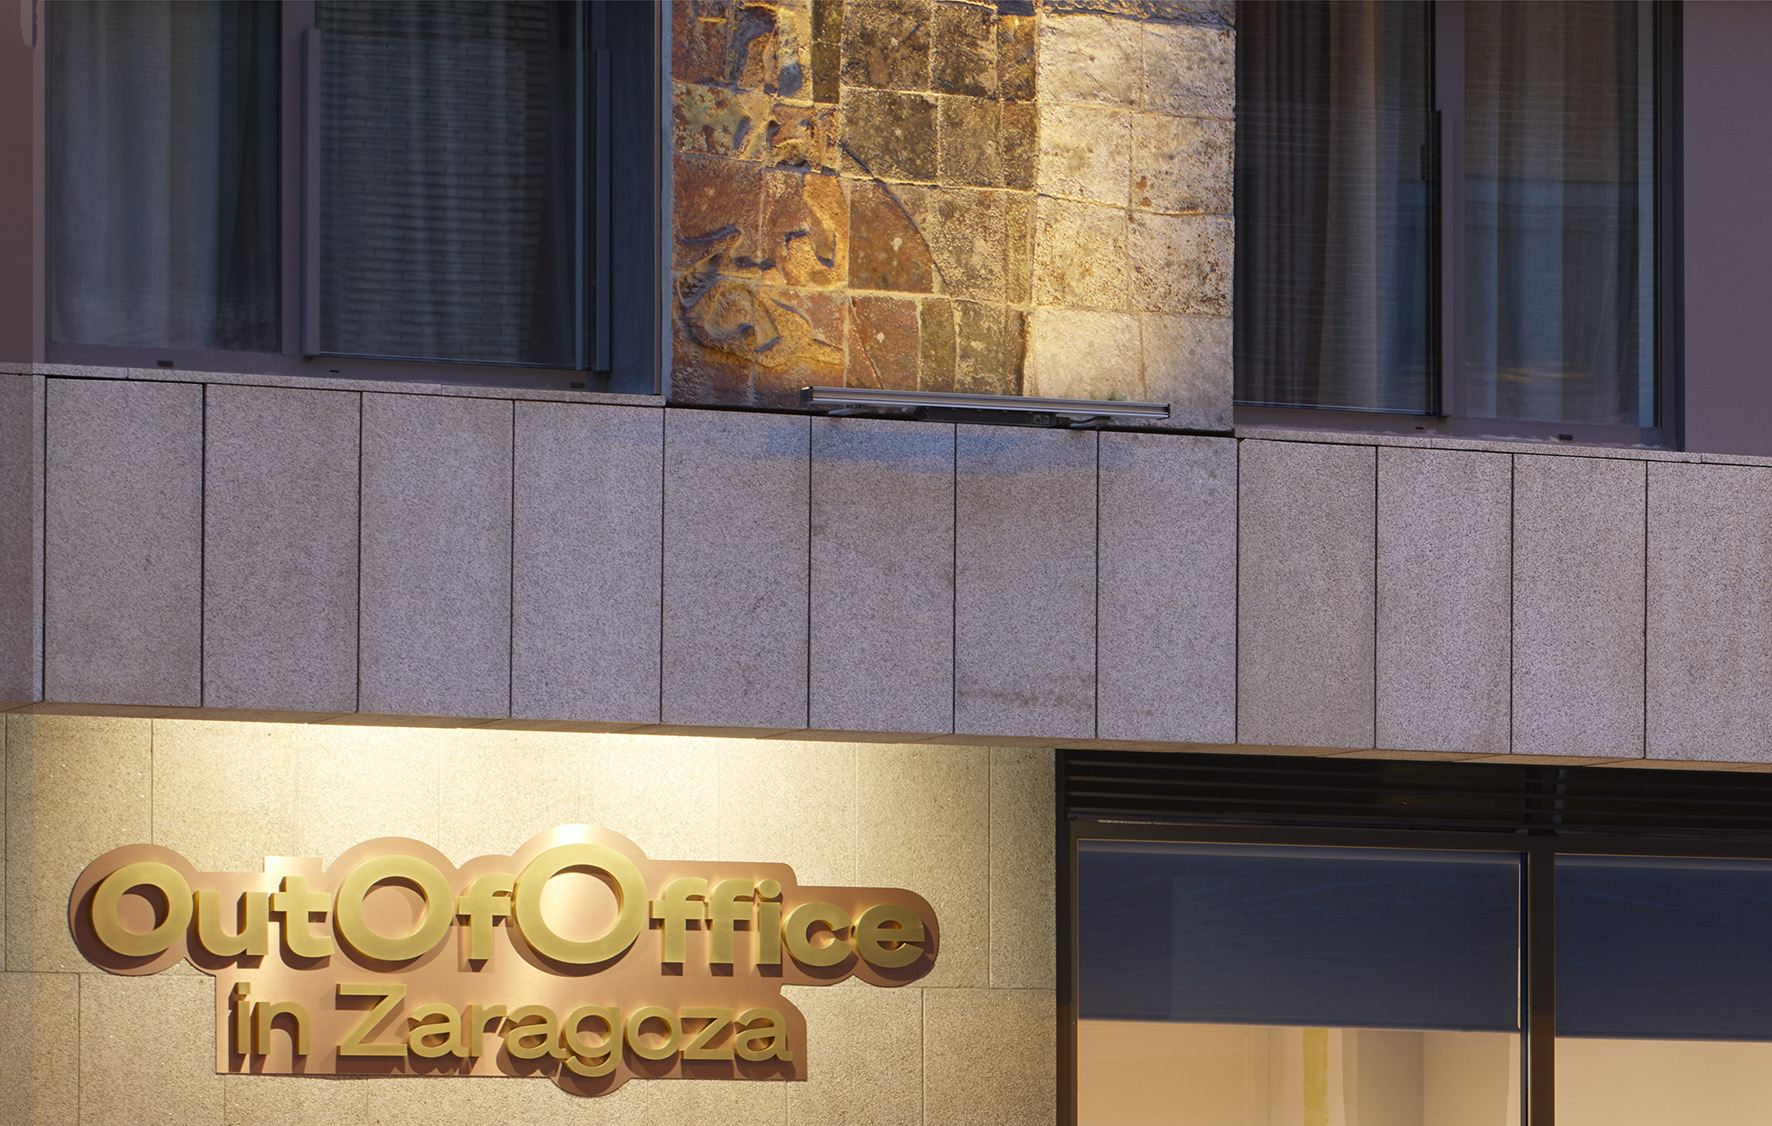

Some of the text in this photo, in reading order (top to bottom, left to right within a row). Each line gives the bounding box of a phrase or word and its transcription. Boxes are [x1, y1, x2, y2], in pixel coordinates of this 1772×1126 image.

[91, 842, 932, 977] OutOfOffice
[230, 982, 795, 1078] in Zaragoza
